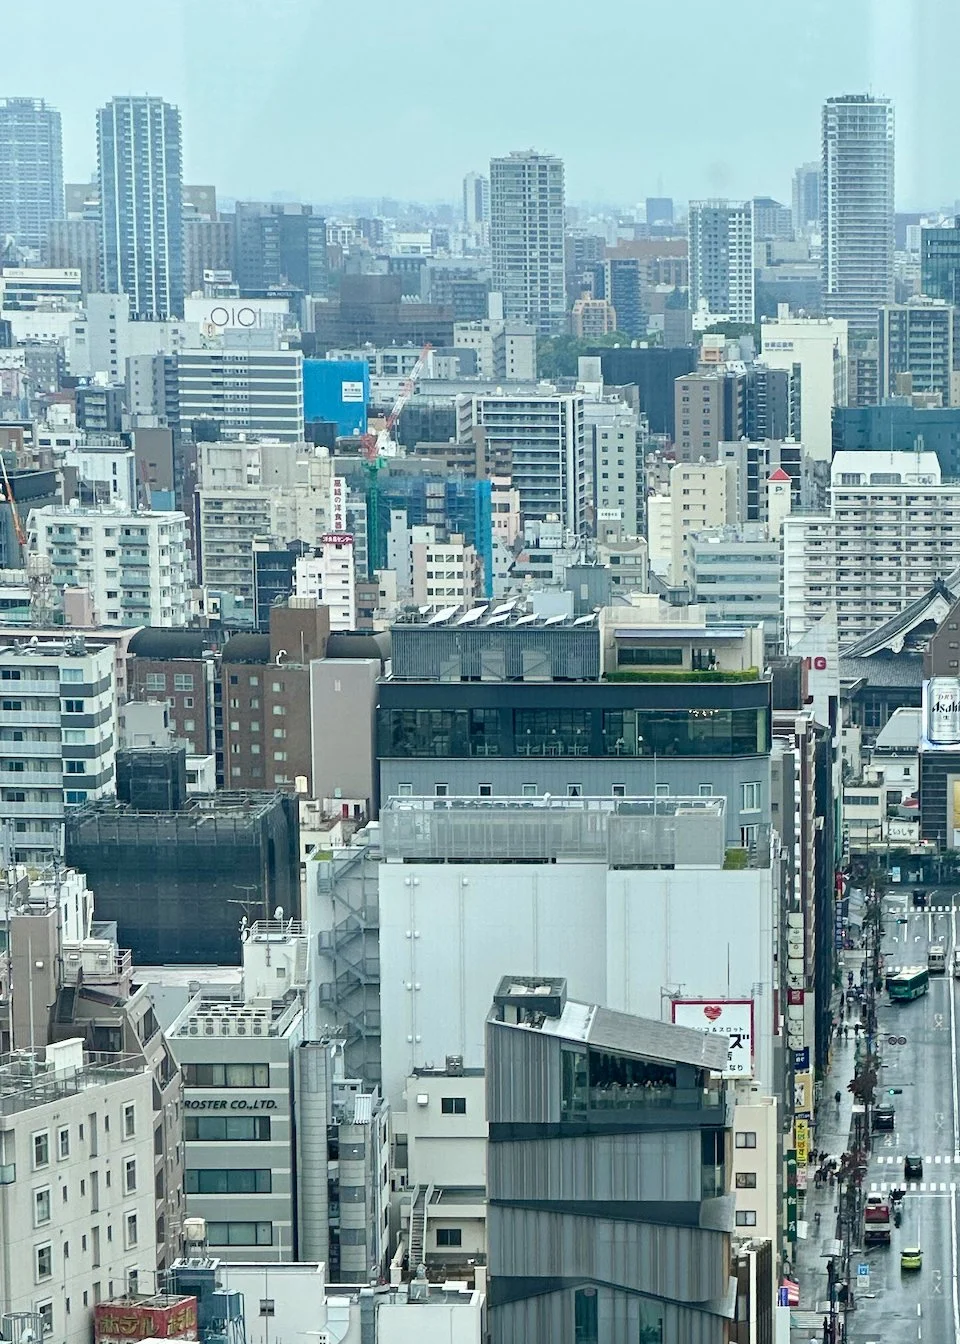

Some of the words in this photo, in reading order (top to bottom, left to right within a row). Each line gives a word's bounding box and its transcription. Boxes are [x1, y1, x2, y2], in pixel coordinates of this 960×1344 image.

[931, 701, 960, 713] Asahi
[100, 1313, 160, 1336] ホテル
